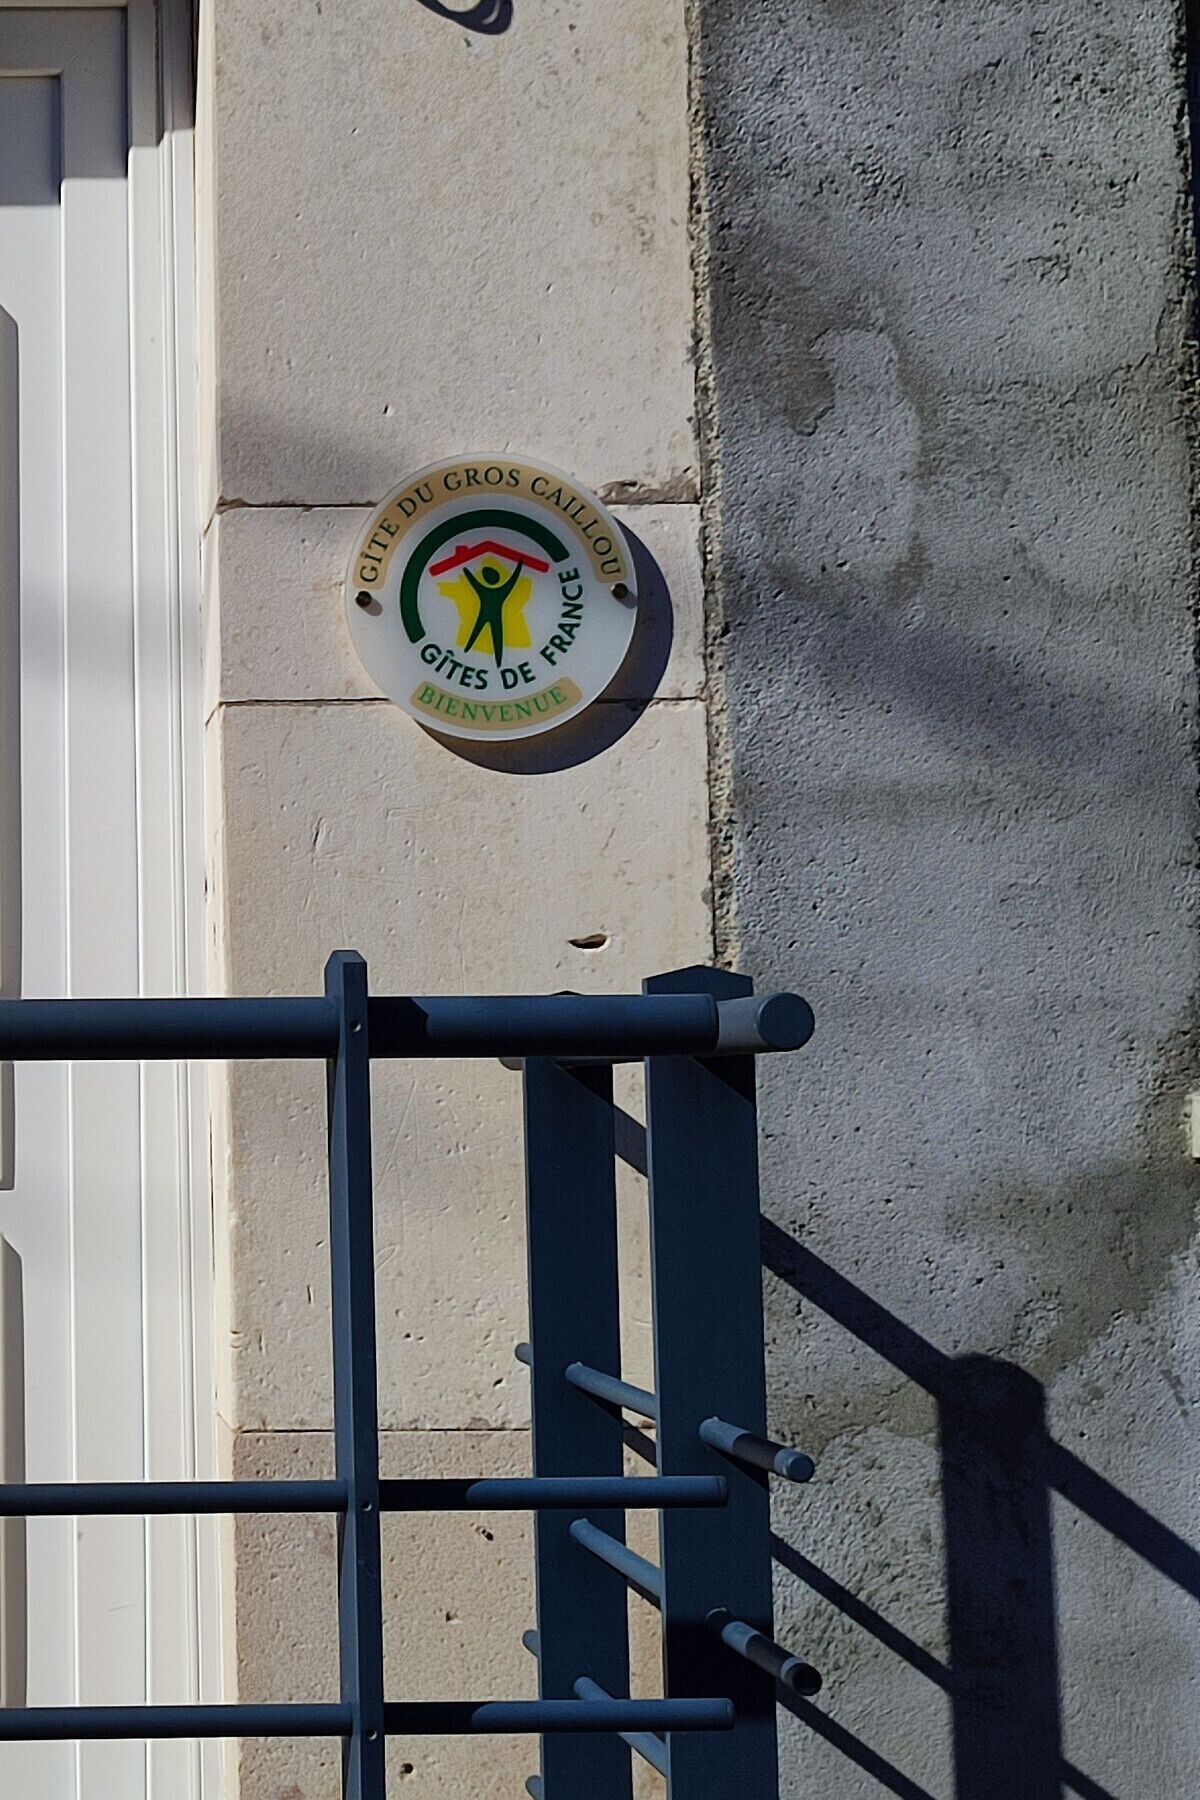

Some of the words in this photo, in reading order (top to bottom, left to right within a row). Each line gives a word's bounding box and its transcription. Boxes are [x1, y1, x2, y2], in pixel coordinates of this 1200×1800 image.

[359, 518, 399, 583] GÎTE
[397, 482, 434, 518] DU
[443, 467, 520, 491] GROS
[531, 477, 620, 577] CAILLOU
[420, 643, 489, 690] GÎTES
[500, 662, 536, 690] DE
[539, 567, 584, 666] FRANCE
[417, 686, 567, 722] BIENVENUE
